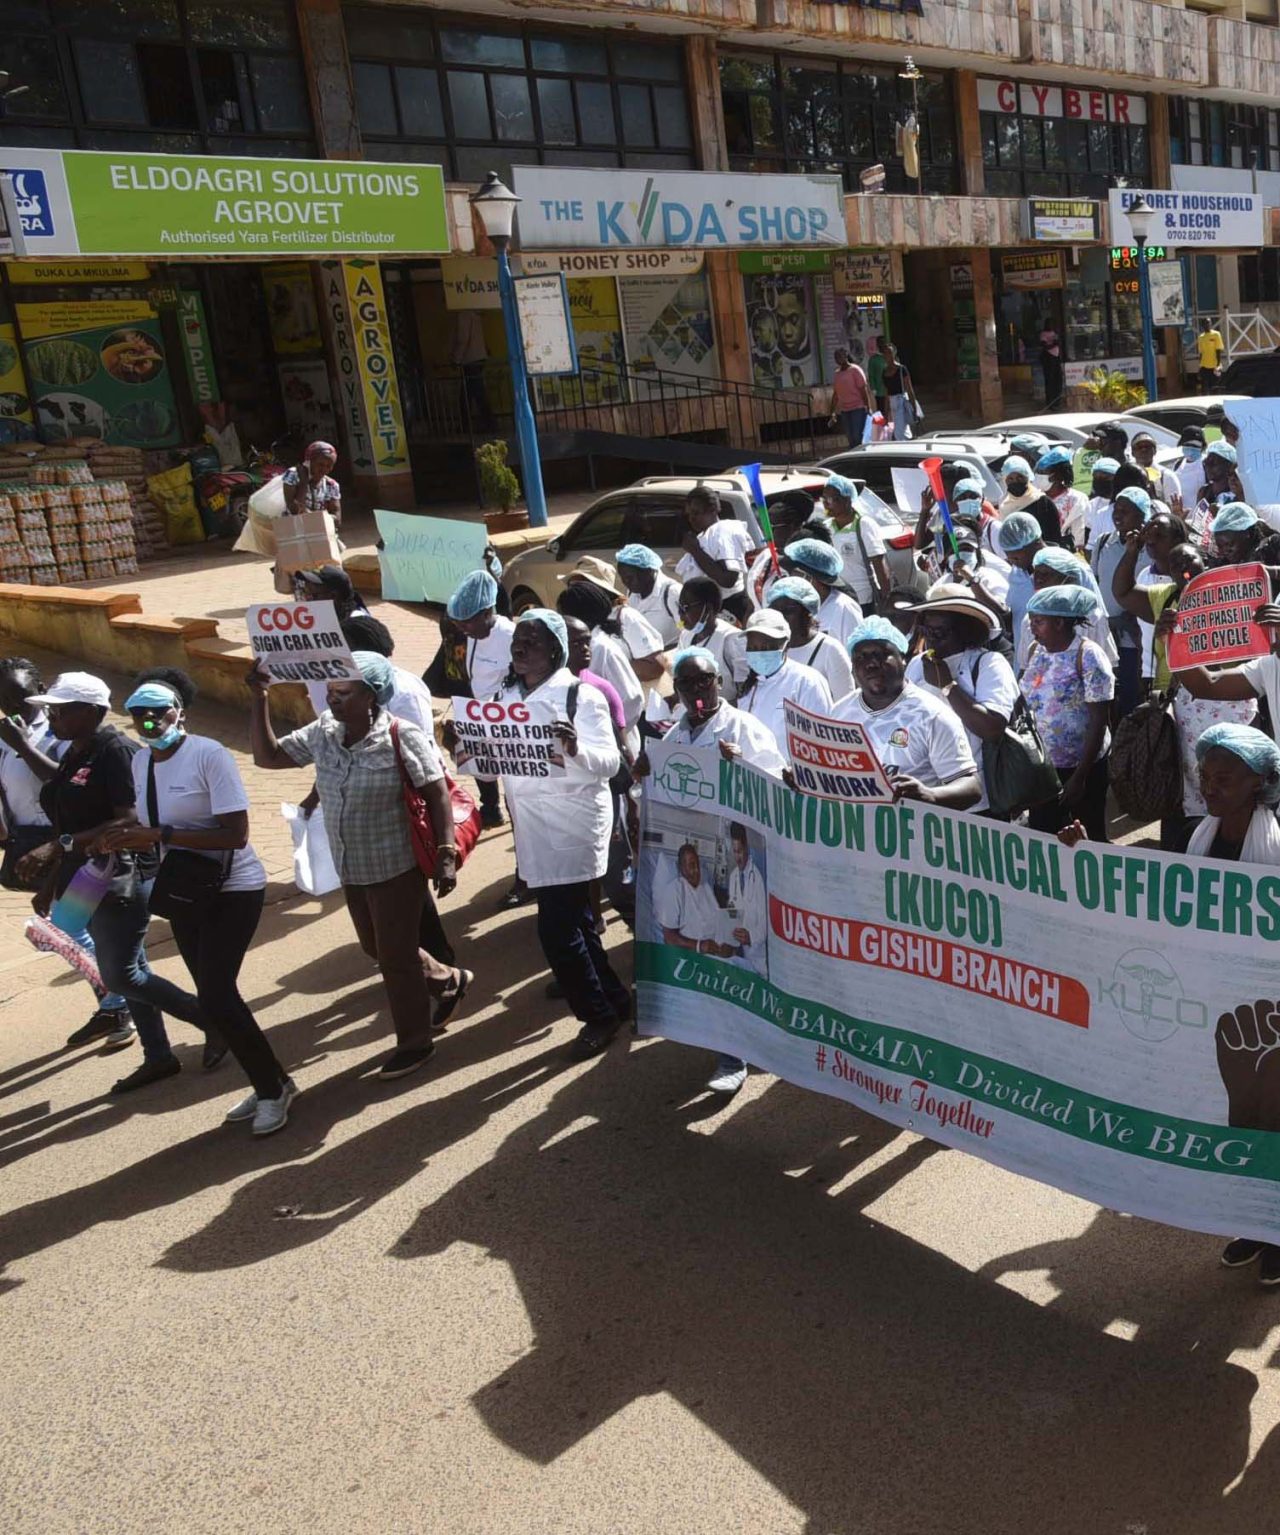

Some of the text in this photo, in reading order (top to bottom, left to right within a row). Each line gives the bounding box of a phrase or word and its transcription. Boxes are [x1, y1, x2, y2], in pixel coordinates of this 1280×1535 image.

[997, 81, 1131, 125] CYBER
[109, 165, 419, 196] ELDOAGRI SOLUTIONS
[214, 200, 344, 225] AGROVET
[1121, 193, 1253, 212] ELORET HOUSEHOLD
[20, 217, 46, 231] RA
[540, 200, 584, 222] THE
[738, 206, 829, 242] SHOP
[1165, 213, 1221, 228] & DECOR
[160, 230, 396, 244] Authorised Yara Fertilizer Distributor
[1167, 230, 1216, 240] 0702 820 762
[34, 267, 130, 278] DUKA LA MKULIMA
[559, 254, 620, 271] HONEY
[626, 253, 671, 269] SHOP
[487, 280, 500, 292] SH
[1115, 281, 1139, 292] CYB
[330, 278, 364, 452] AGROVET
[356, 276, 397, 451] AGROVET
[1202, 589, 1215, 606] ALL
[1217, 581, 1263, 603] ARREARS
[257, 606, 314, 632] COG
[1182, 606, 1251, 633] AS PER PHASE III
[252, 631, 343, 653] SIGN CBA FOR
[1188, 627, 1249, 653] SRC CYCLE
[269, 659, 349, 682] NURSES
[466, 700, 531, 722] COG
[455, 721, 551, 739] SIGN CBA FOR
[786, 710, 864, 745] NO PNP LETTERS
[463, 740, 555, 760] HEALTHCARE
[793, 739, 864, 769] FOR UHC
[475, 758, 549, 777] WORKERS
[795, 763, 885, 797] NO WORK
[718, 759, 773, 828] KENYA
[774, 783, 866, 852] UNION
[875, 804, 915, 860] OF
[923, 812, 1068, 903] CLINICAL
[780, 908, 1060, 1015] UASIN GISHU BRANCH
[673, 957, 1255, 1168] United We BARGAIN, Divided We BEG
[831, 1051, 902, 1105] Stronger
[908, 1079, 995, 1138] Together
